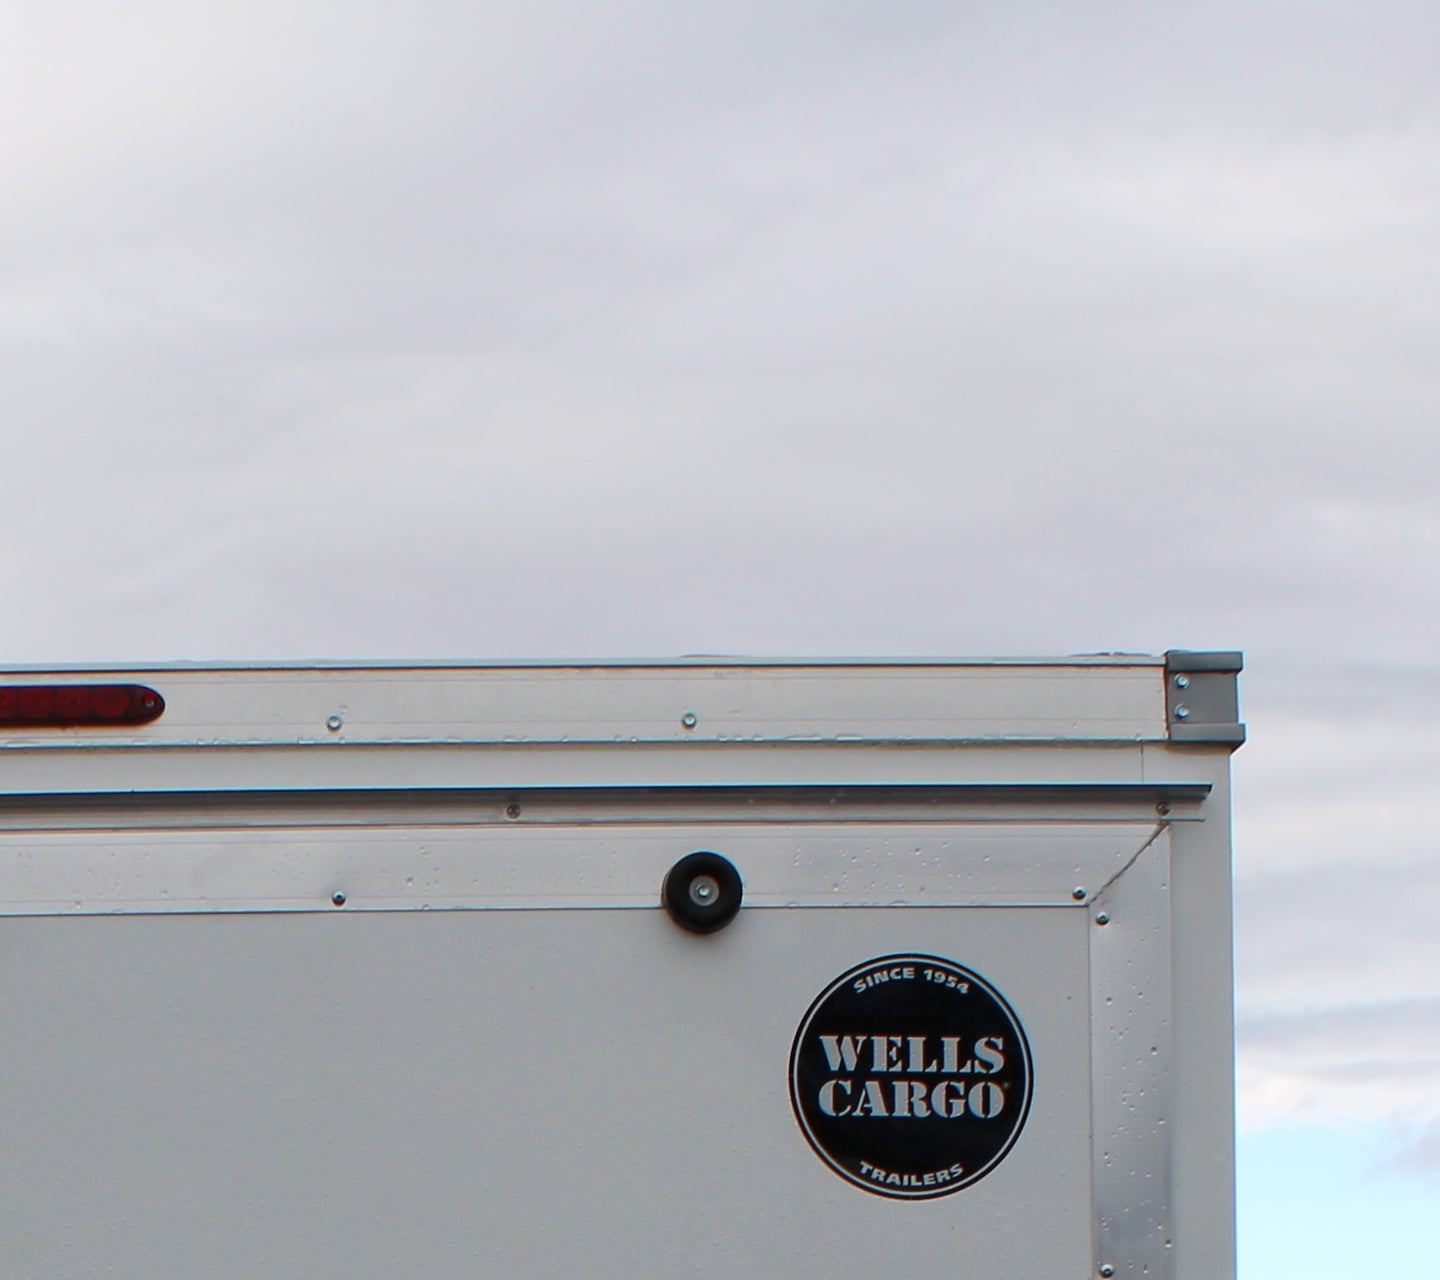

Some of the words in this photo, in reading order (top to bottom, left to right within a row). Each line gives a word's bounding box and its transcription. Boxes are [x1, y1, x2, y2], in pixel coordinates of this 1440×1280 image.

[852, 967, 915, 994] SINCE
[923, 969, 970, 995] 1954
[819, 1035, 1005, 1074] WELLS
[818, 1079, 1005, 1119] CARGO
[859, 1160, 964, 1186] TRAILERS
